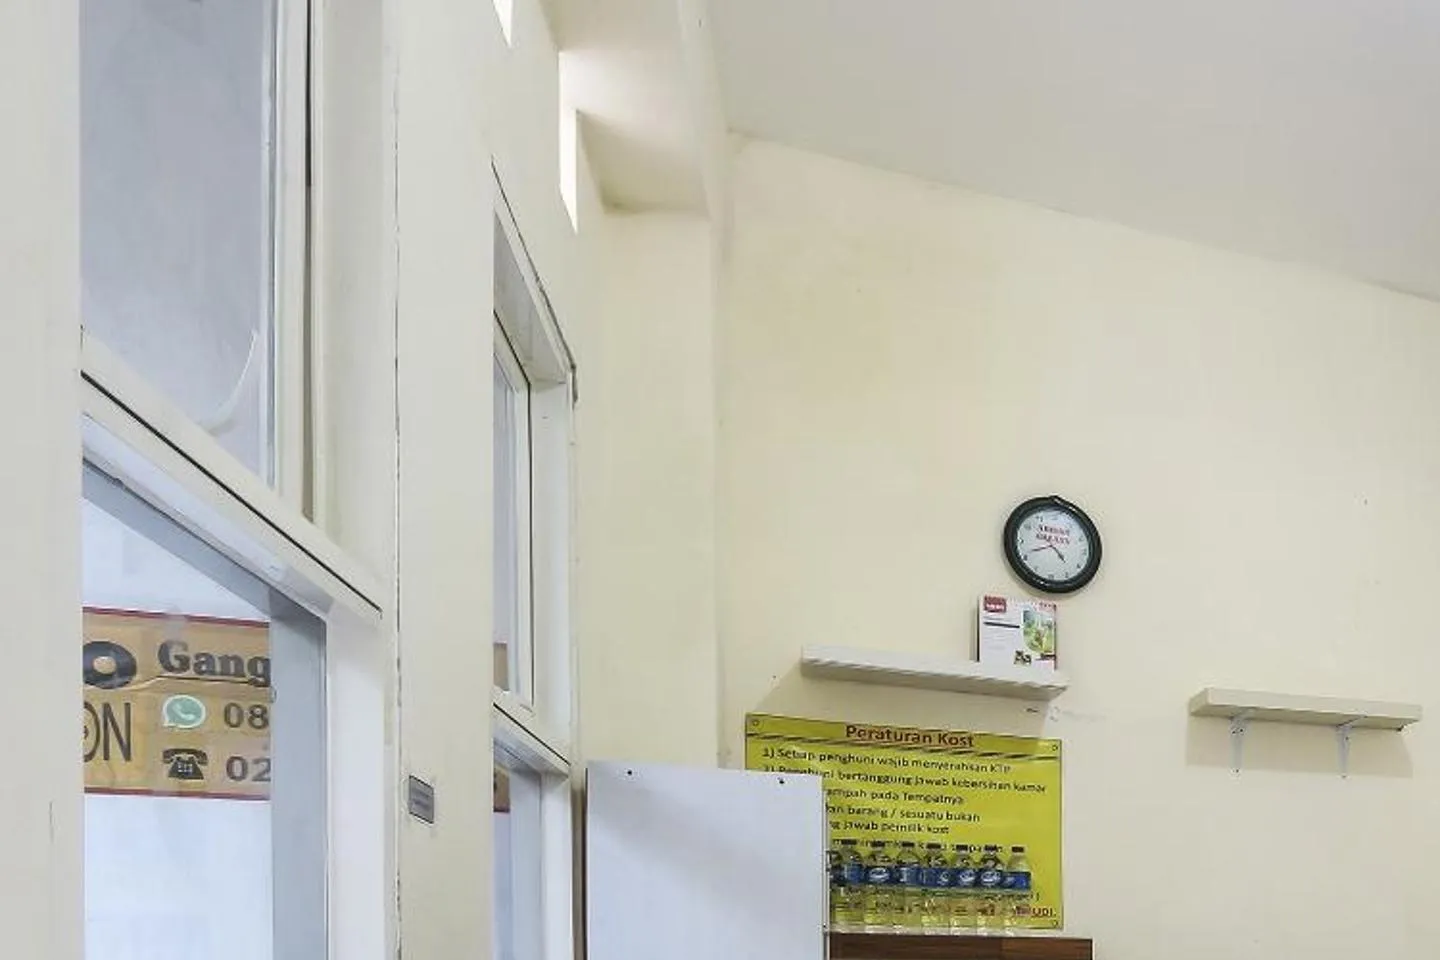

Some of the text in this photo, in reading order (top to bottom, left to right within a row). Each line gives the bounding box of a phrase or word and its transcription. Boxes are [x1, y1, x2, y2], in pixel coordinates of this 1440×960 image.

[157, 640, 271, 688] Gang
[223, 703, 269, 730] 08
[846, 725, 974, 748] Peraturan Kost
[819, 752, 875, 765] penghuni
[878, 756, 909, 768] wajib
[871, 790, 900, 803] pada
[900, 810, 943, 820] sesuatu
[946, 811, 980, 822] bukan
